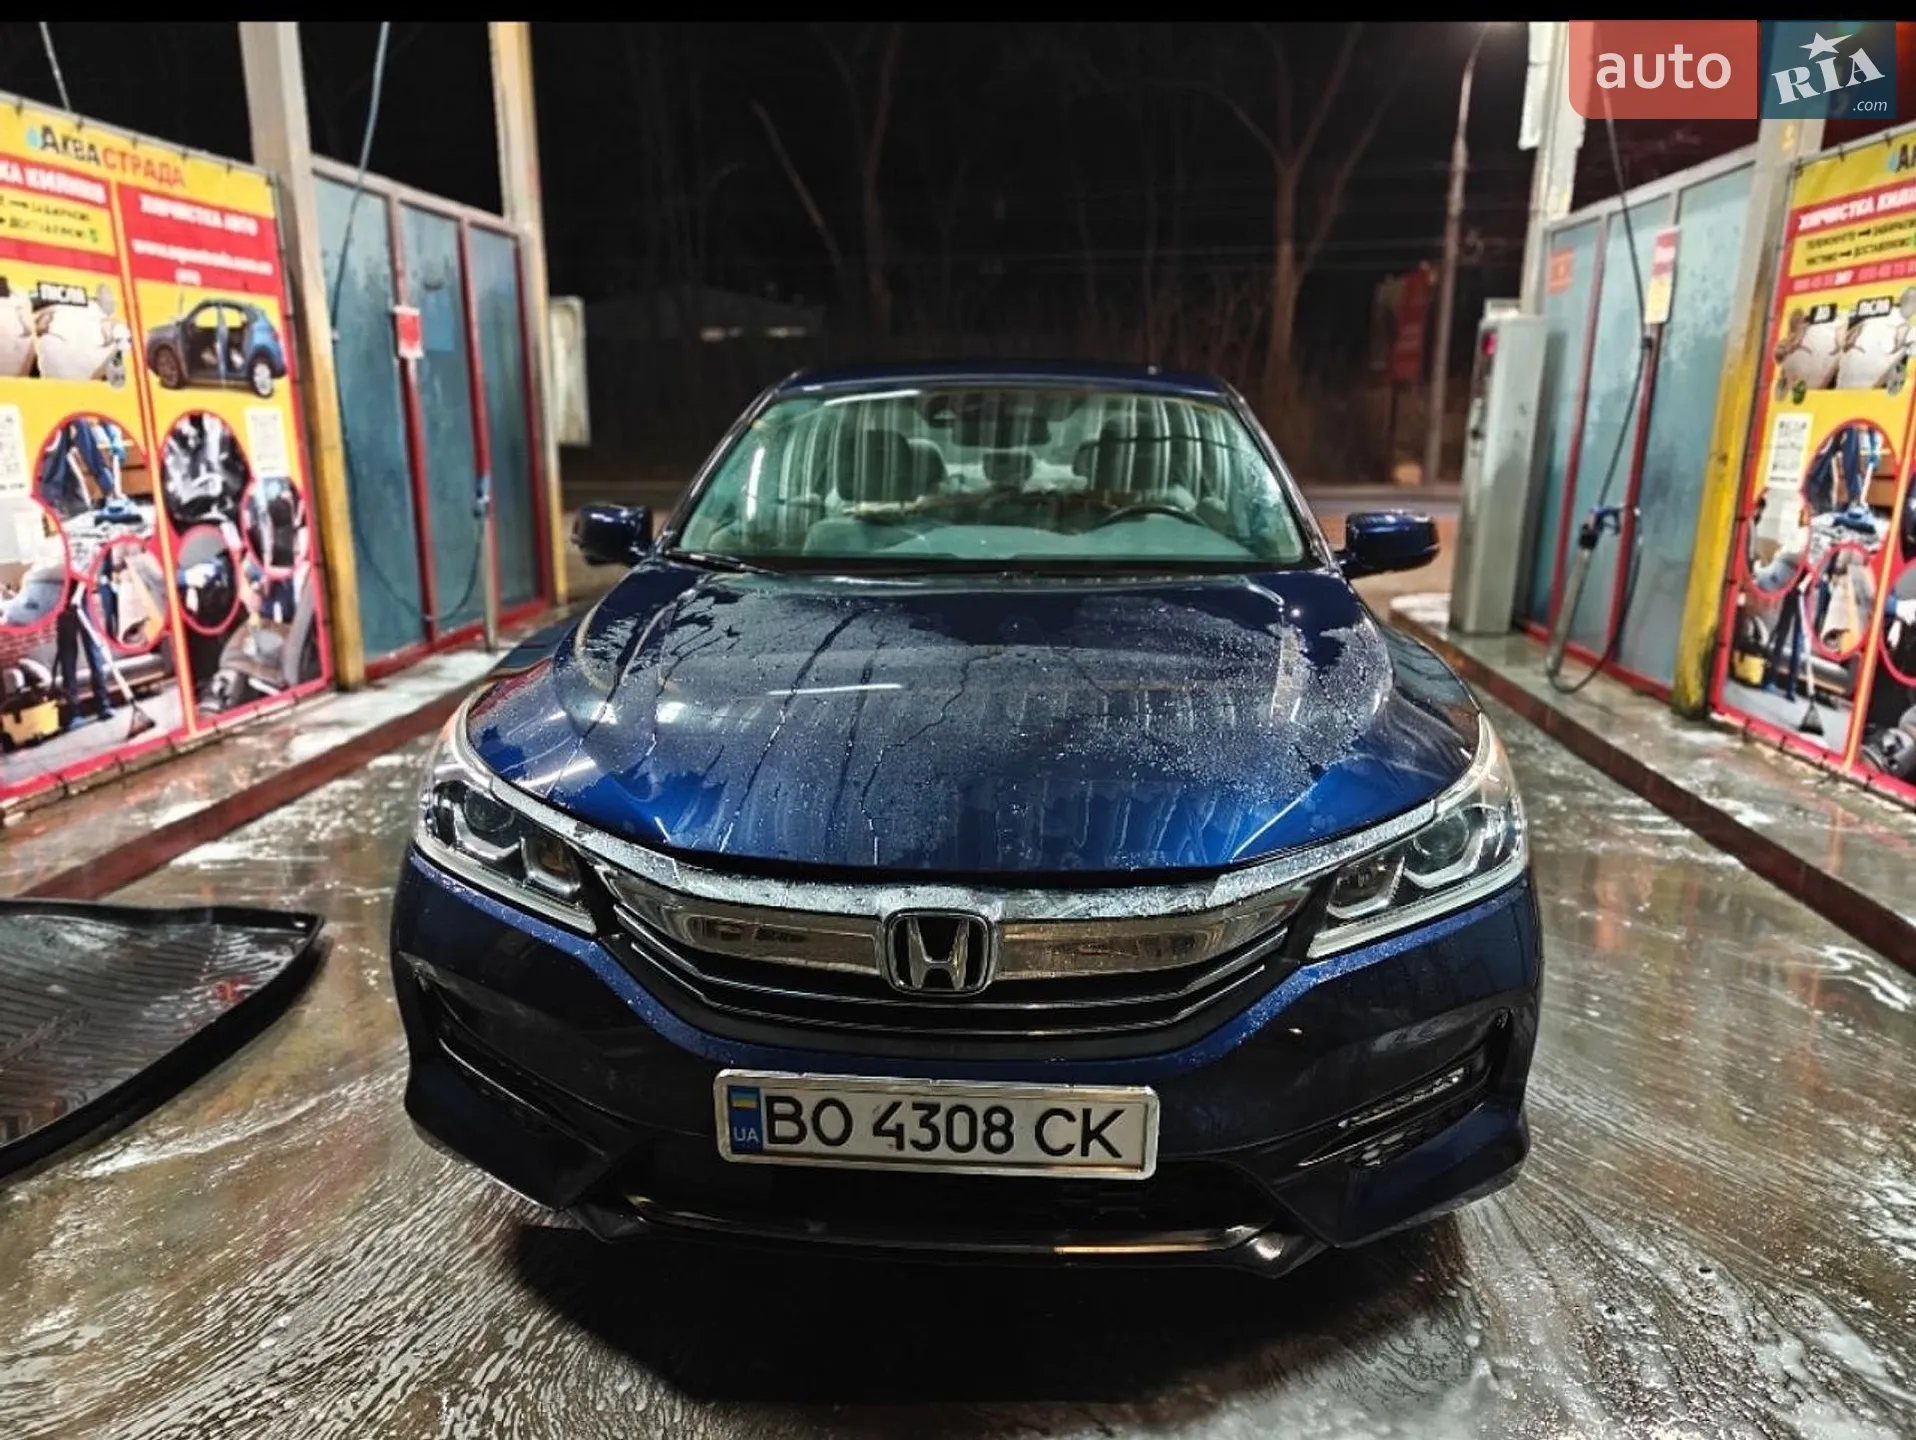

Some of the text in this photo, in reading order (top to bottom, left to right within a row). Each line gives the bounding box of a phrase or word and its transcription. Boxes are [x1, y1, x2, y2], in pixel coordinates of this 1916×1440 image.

[733, 1127, 760, 1144] UA
[765, 1095, 1125, 1159] BO 4308 CK
